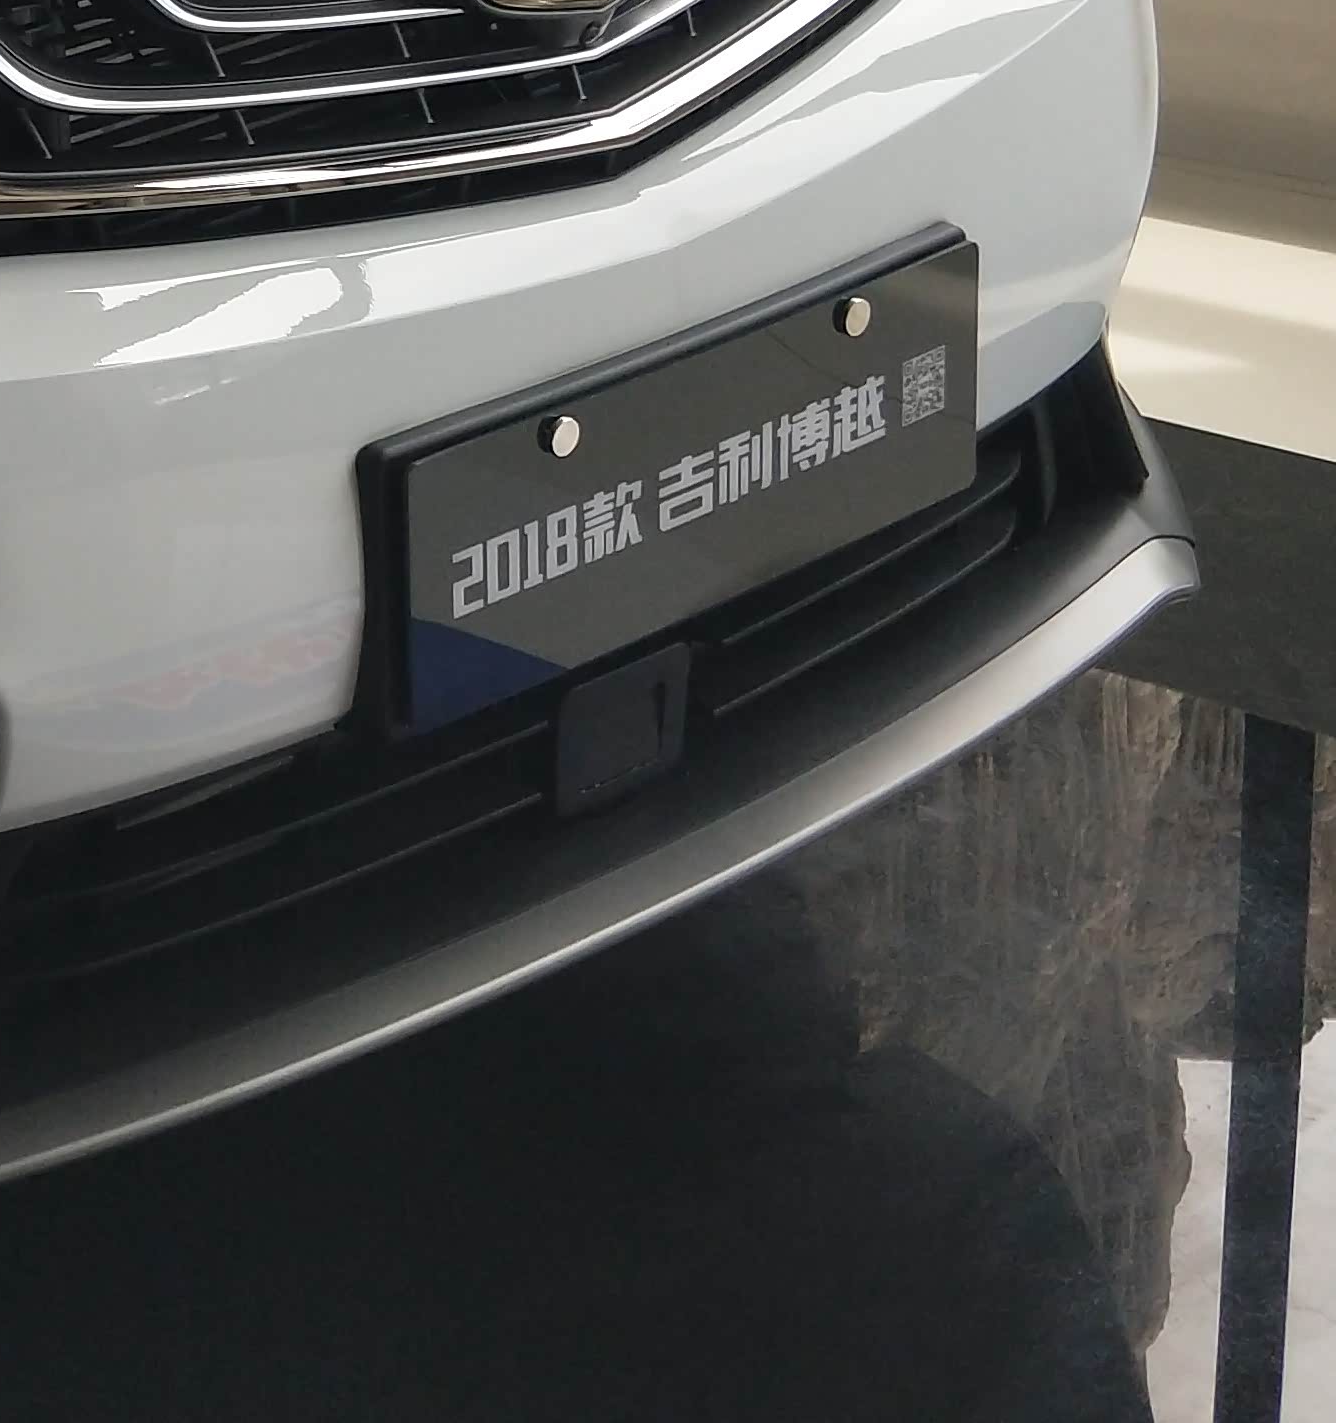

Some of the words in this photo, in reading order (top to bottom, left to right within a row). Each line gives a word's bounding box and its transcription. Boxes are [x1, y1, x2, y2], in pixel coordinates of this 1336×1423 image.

[451, 480, 644, 620] 2018款
[658, 375, 886, 532] 吉利博越
